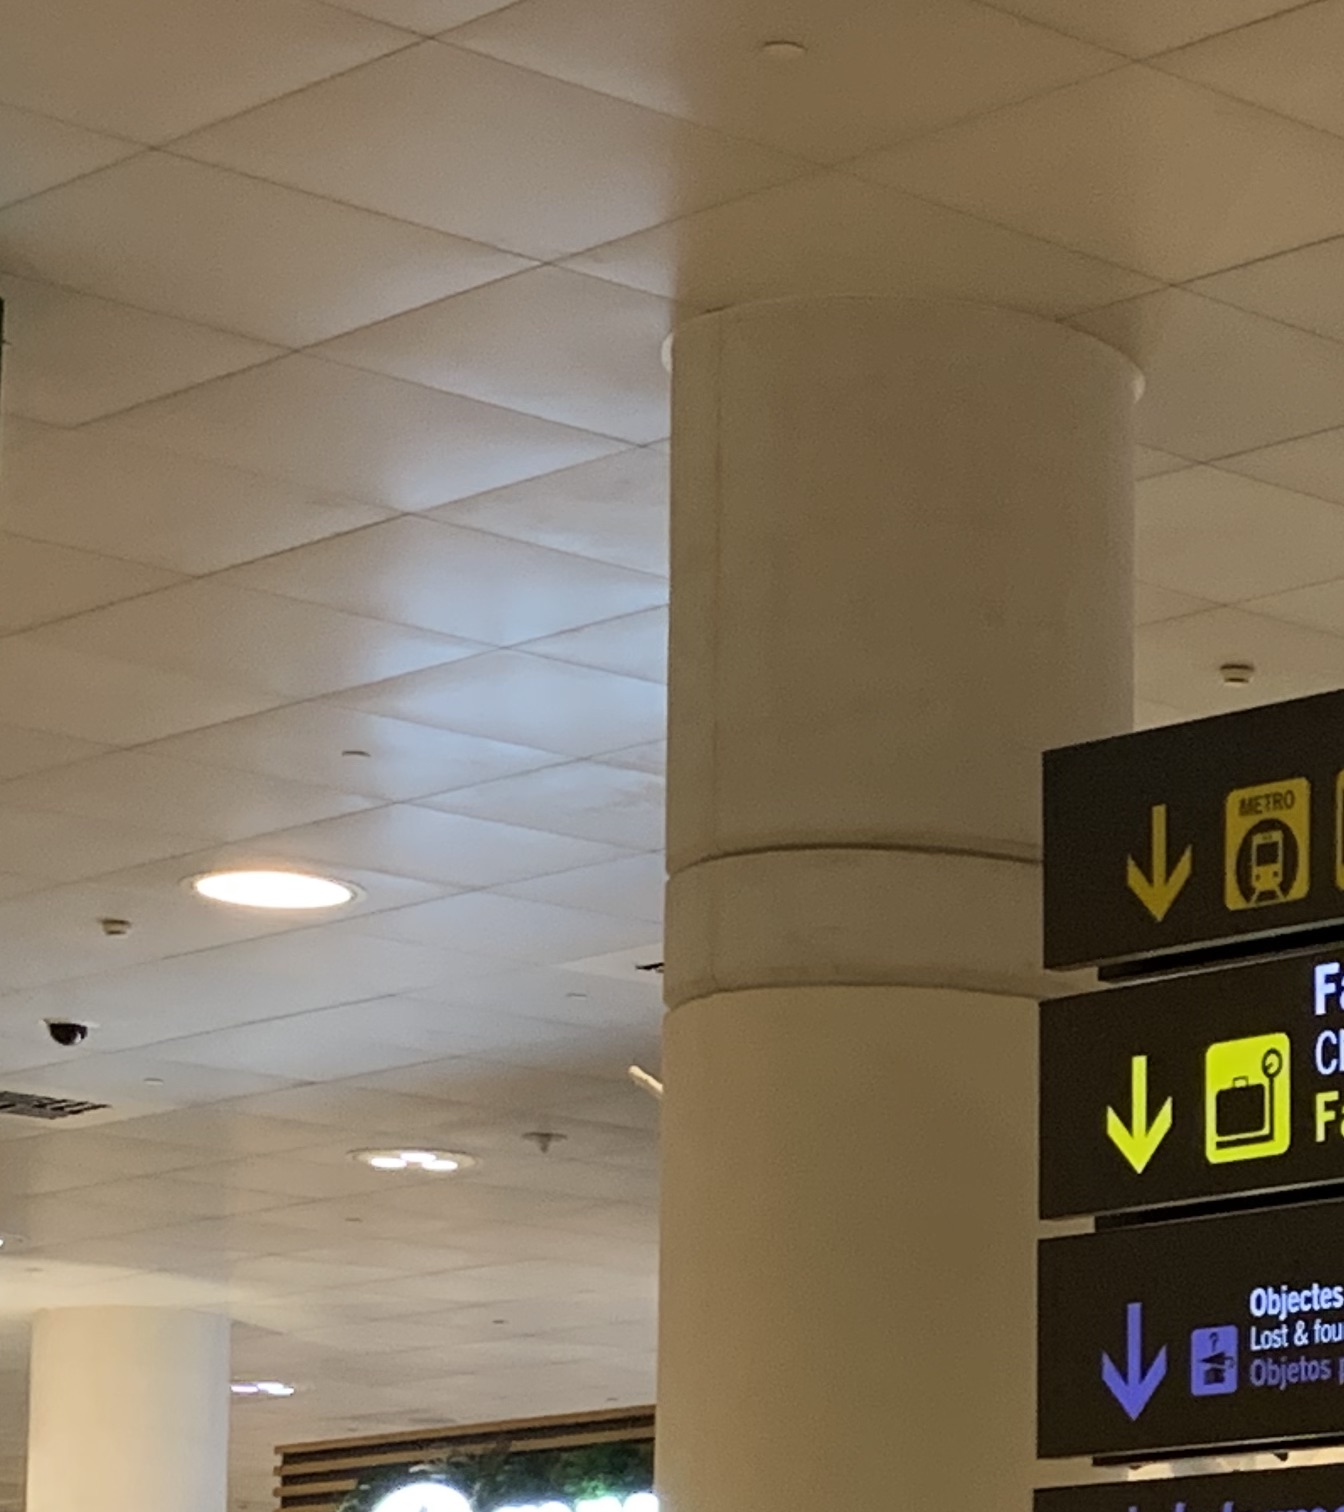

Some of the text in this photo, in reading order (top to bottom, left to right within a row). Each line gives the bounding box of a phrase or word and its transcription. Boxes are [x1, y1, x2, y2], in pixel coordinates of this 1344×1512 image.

[1238, 789, 1295, 816] METRO
[1249, 1283, 1344, 1321] Objectes
[1250, 1324, 1289, 1351] Lost
[1293, 1320, 1309, 1347] &
[1249, 1355, 1332, 1391] Objetos
